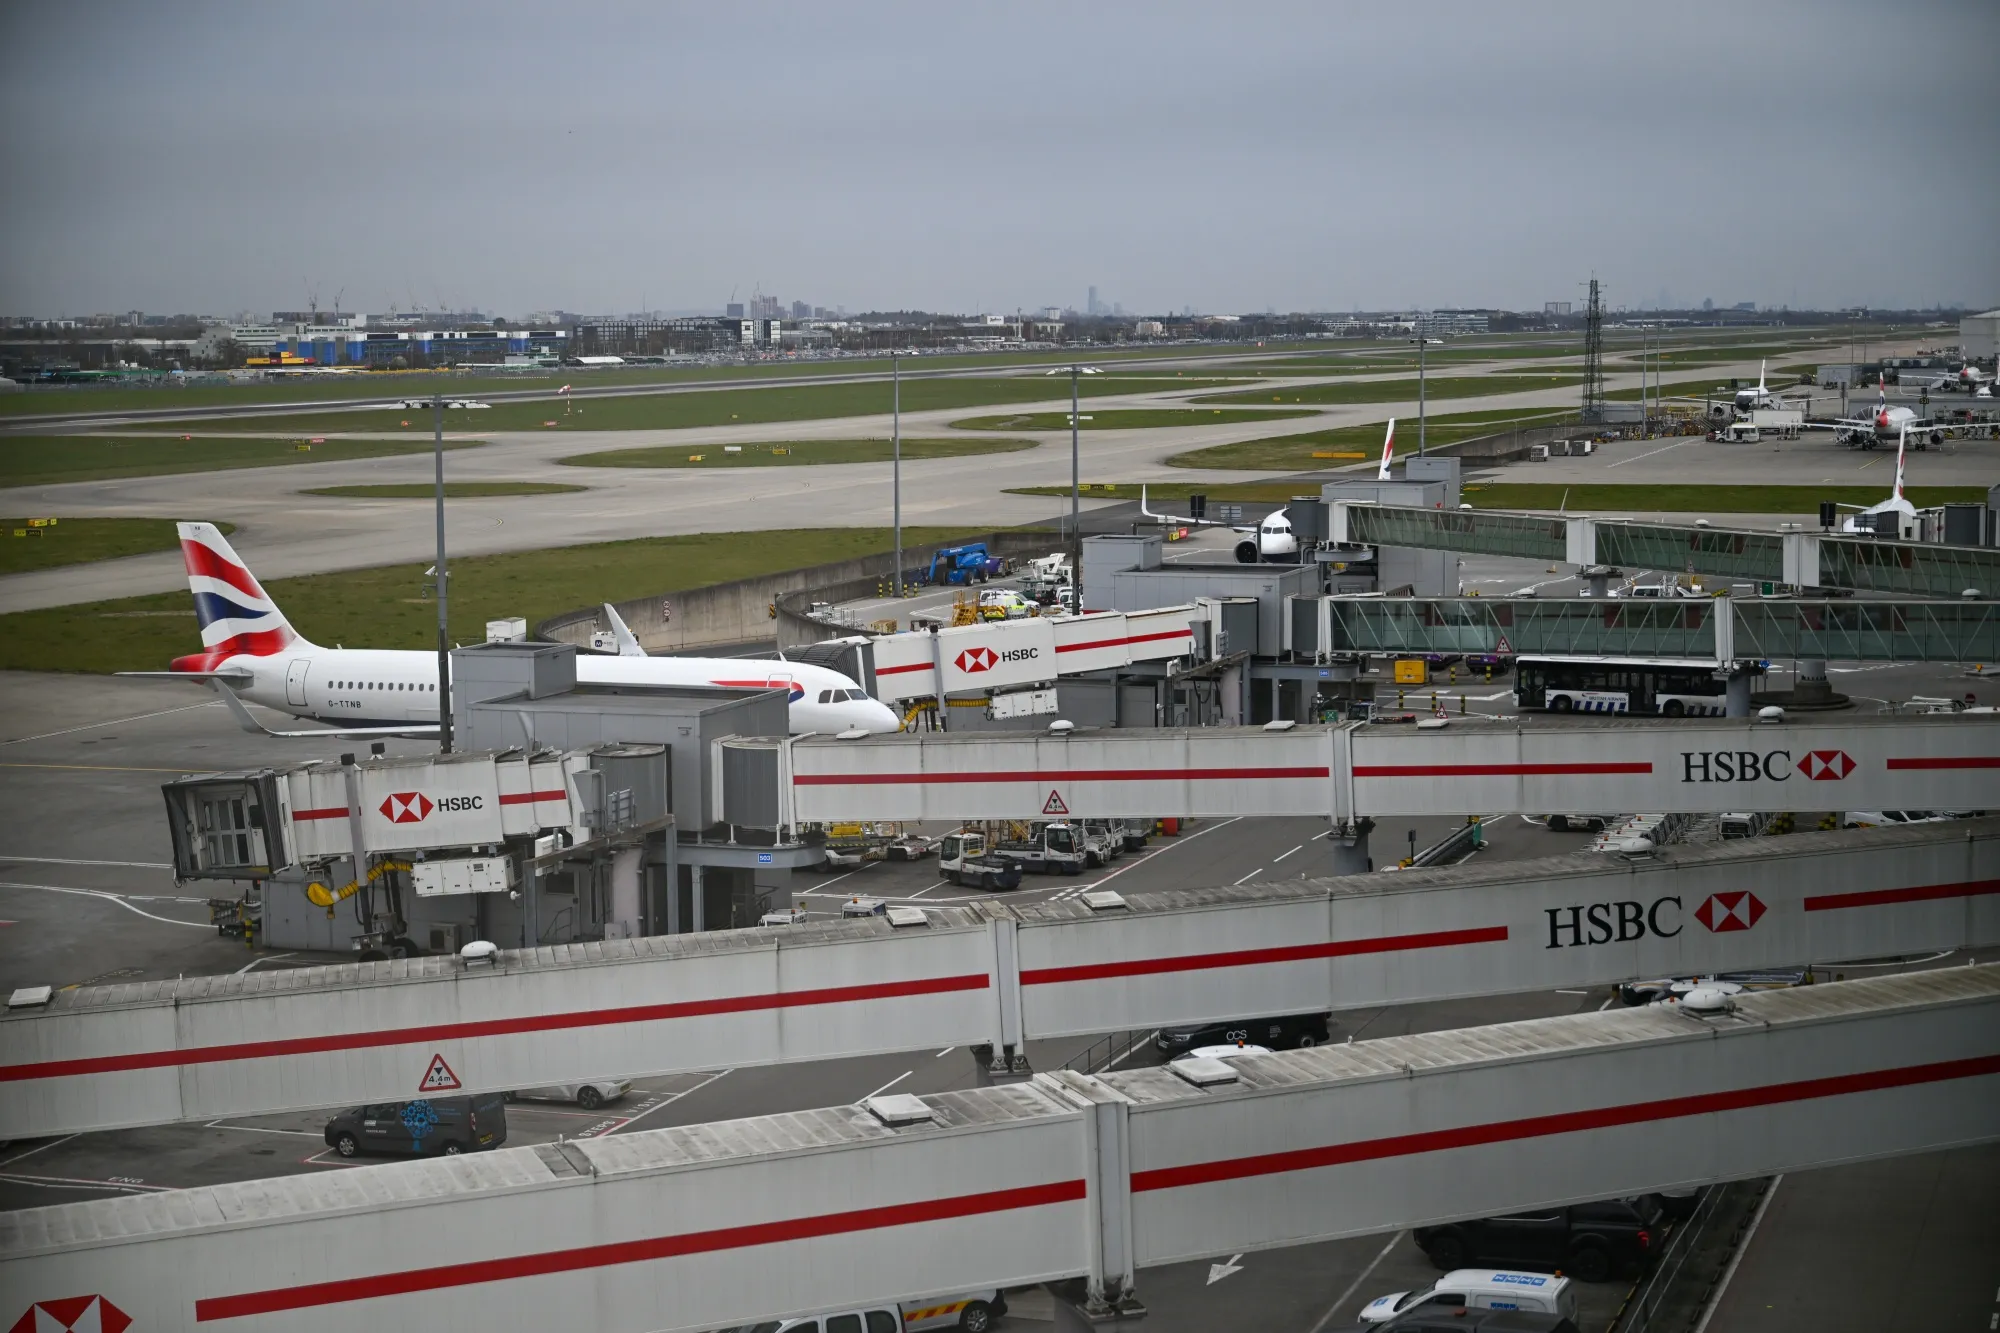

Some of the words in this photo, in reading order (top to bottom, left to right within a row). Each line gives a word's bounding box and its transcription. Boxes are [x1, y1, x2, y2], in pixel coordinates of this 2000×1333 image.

[1001, 647, 1039, 663] HSBC
[328, 700, 361, 709] G-TTNB
[1681, 750, 1791, 783] HSBC
[437, 796, 483, 813] HSBC
[1545, 896, 1683, 948] HSBC
[1226, 1029, 1247, 1040] OCS
[1492, 1274, 1547, 1286] KONE
